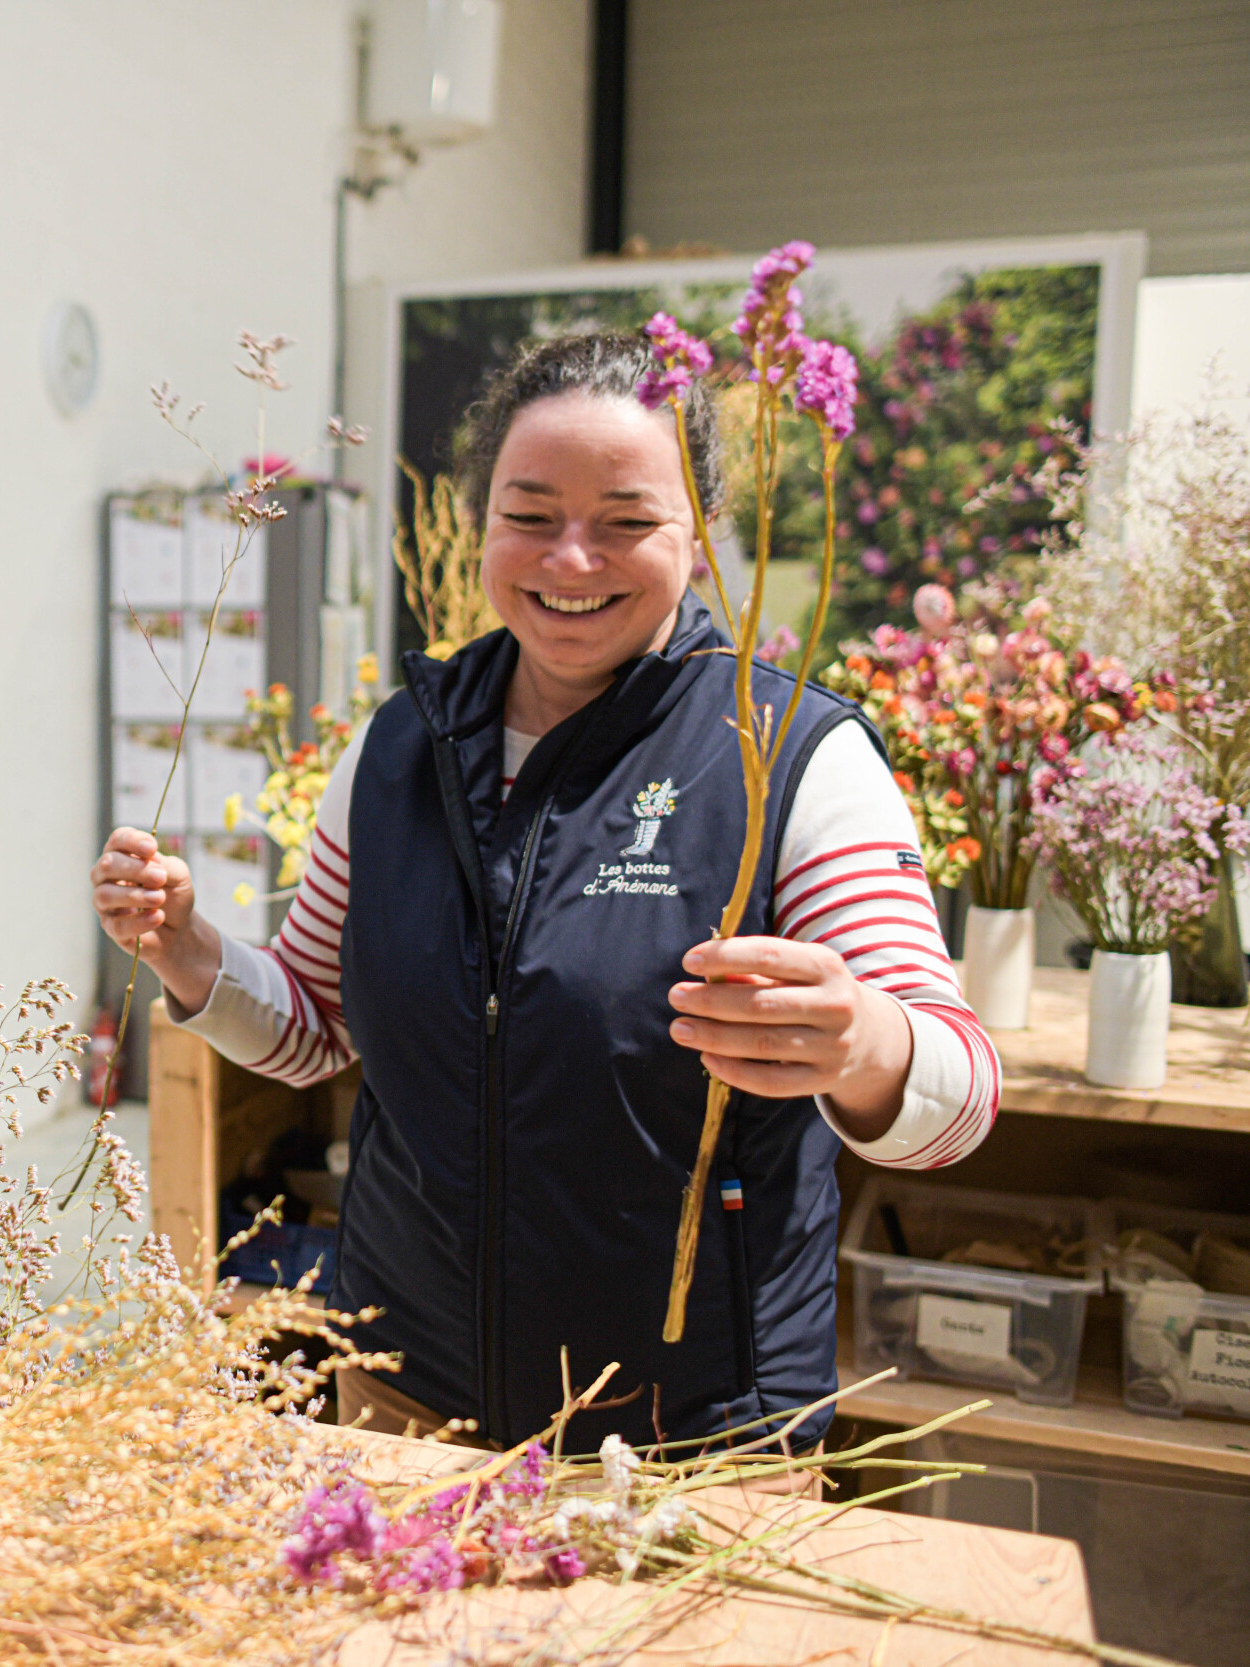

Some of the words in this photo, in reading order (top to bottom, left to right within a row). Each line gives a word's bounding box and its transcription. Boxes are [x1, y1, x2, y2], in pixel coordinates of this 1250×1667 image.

[598, 864, 622, 876] Les
[625, 862, 670, 875] bottes
[583, 875, 679, 896] d'Anémone
